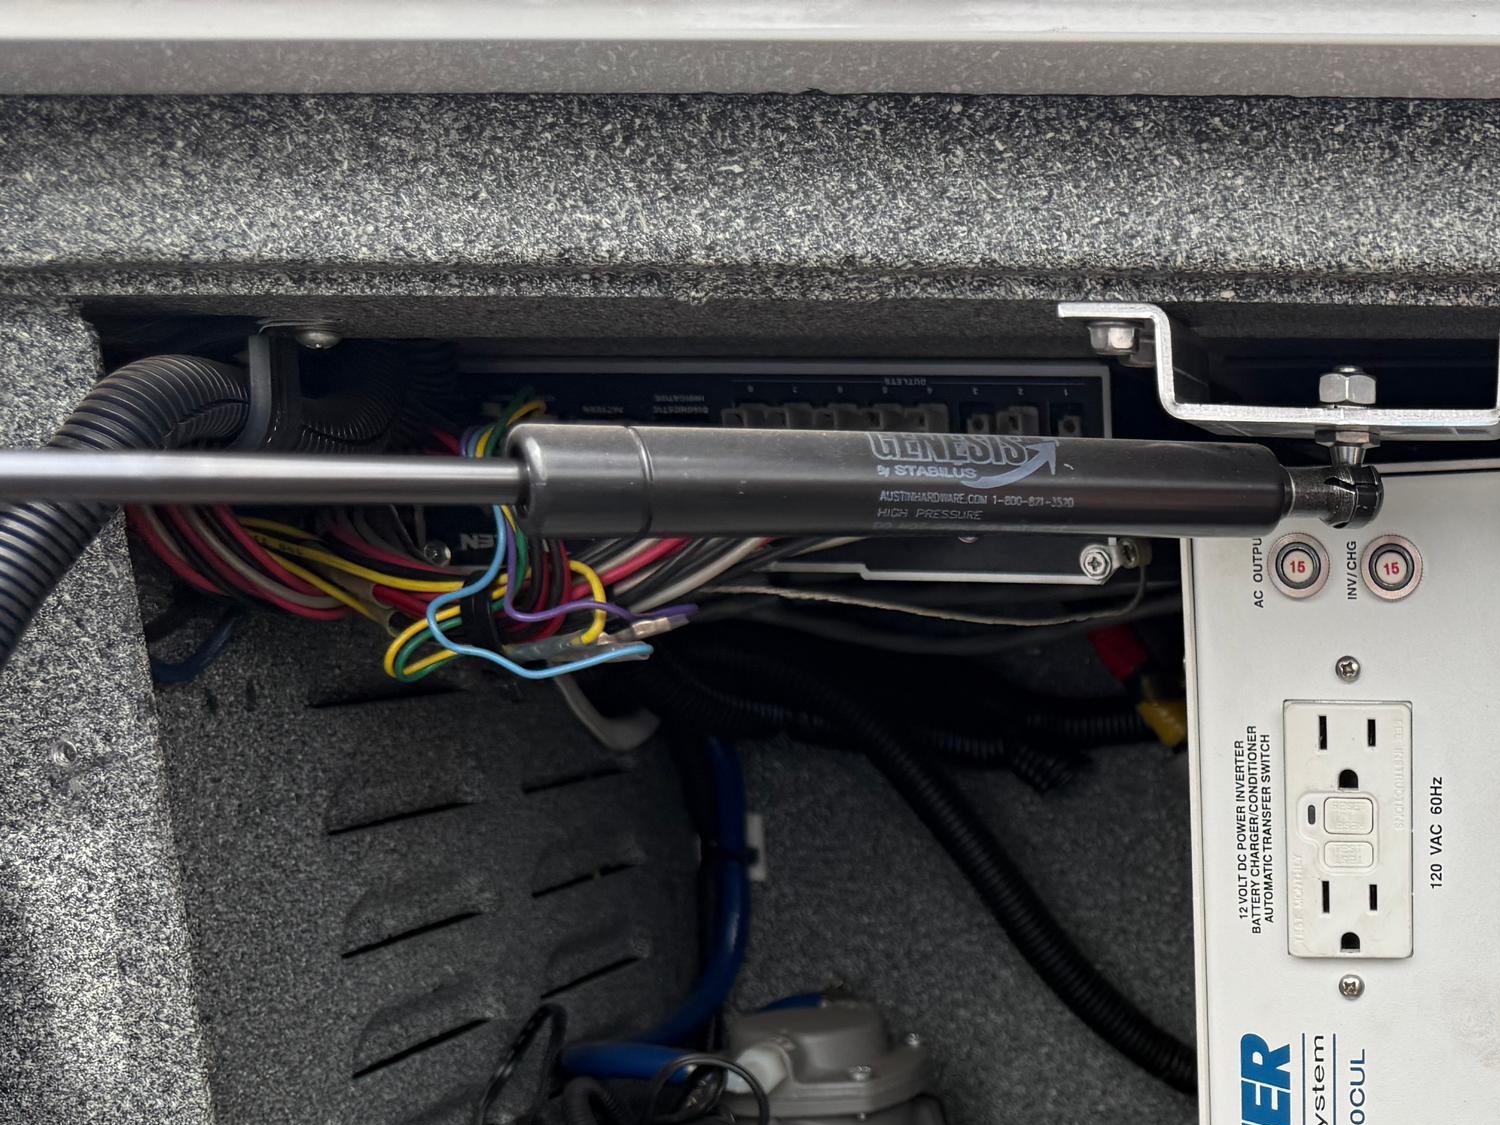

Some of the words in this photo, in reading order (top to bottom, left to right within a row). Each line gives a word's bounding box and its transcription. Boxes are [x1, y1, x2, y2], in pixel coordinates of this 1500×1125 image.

[865, 432, 1029, 466] GENESIS
[895, 465, 977, 479] STABILUS
[880, 491, 987, 504] AUSTINHARDWARE.COM
[877, 508, 909, 518] HIGH
[916, 509, 984, 520] PRESSURE
[1252, 538, 1263, 583] OUTPU
[1290, 560, 1305, 573] 15
[1347, 541, 1357, 600] INV/CHG
[1383, 562, 1399, 576] 15
[1254, 590, 1264, 608] AC
[1235, 741, 1245, 802] INVERTER
[1260, 734, 1270, 783] SWITCH
[1247, 726, 1260, 877] CHARGER/CONDITIONER
[1430, 777, 1442, 814] 60Hz
[1236, 806, 1246, 850] POWER
[1261, 787, 1272, 852] TRANSFER
[1430, 824, 1442, 855] VAC
[1237, 854, 1247, 871] DC
[1431, 864, 1442, 889] 120
[1238, 875, 1248, 904] VOLT
[1262, 854, 1273, 923] AUTOMATIC
[1239, 907, 1248, 919] 12
[1250, 880, 1261, 934] BATTERY
